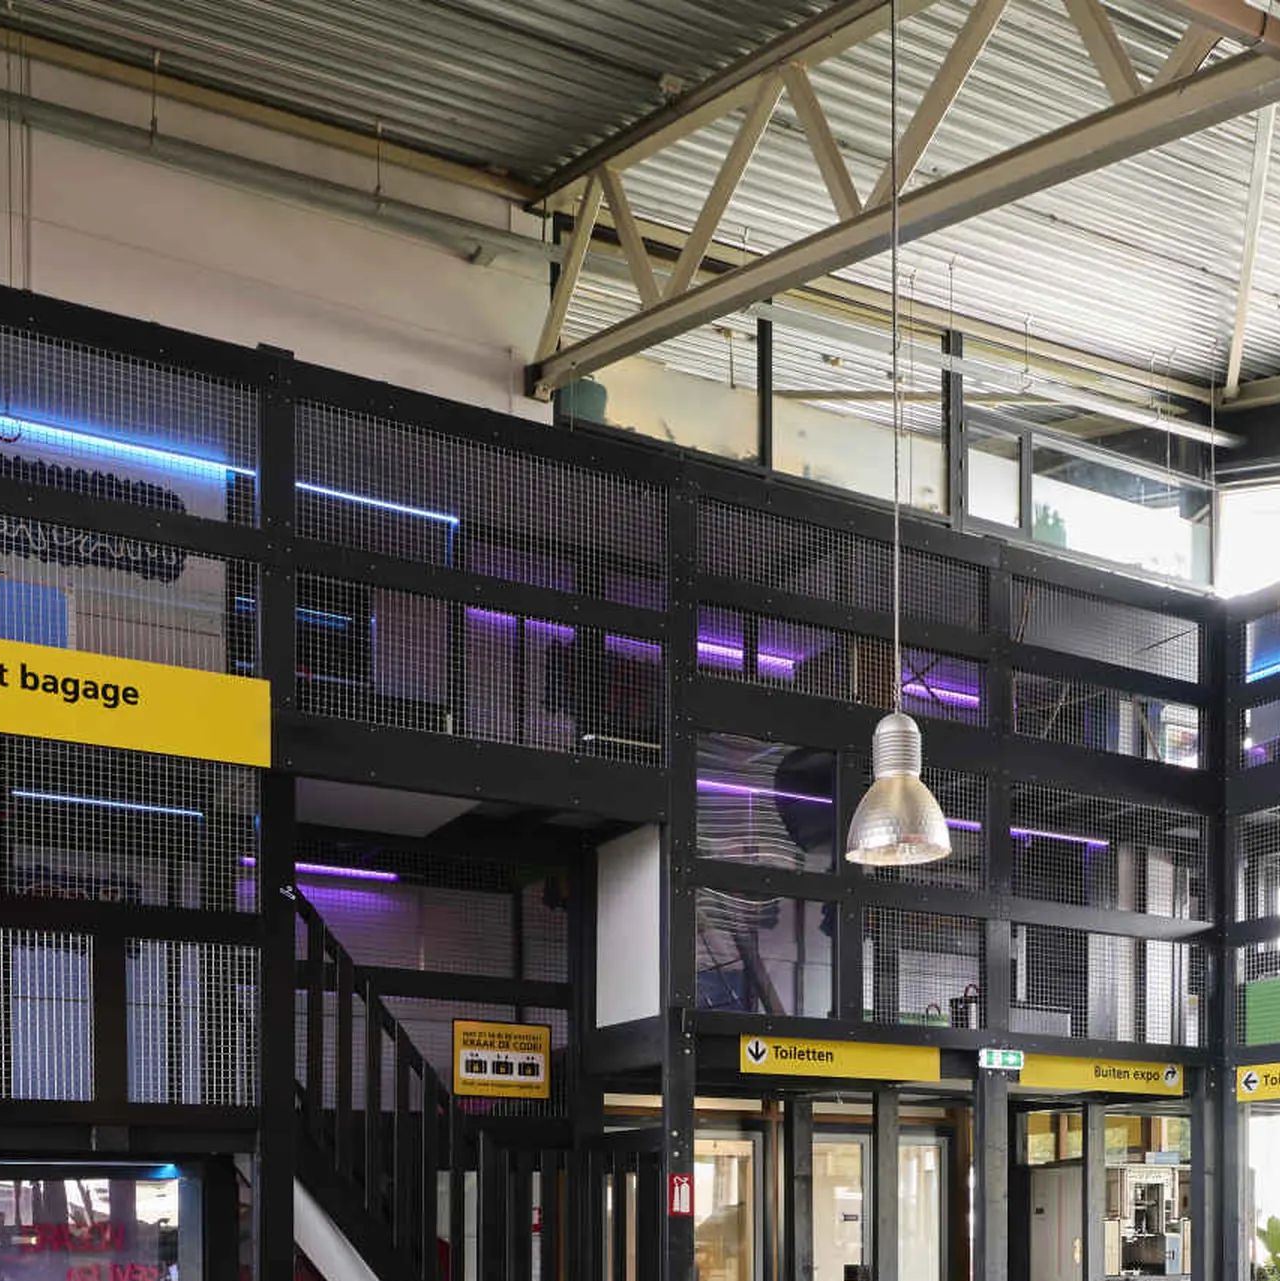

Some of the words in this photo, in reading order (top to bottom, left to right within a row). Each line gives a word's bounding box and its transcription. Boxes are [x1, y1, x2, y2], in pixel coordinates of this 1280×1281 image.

[20, 663, 141, 709] bagage
[772, 1044, 834, 1064] Toiletten
[1094, 1065, 1130, 1081] Buiten
[1133, 1068, 1160, 1083] expo
